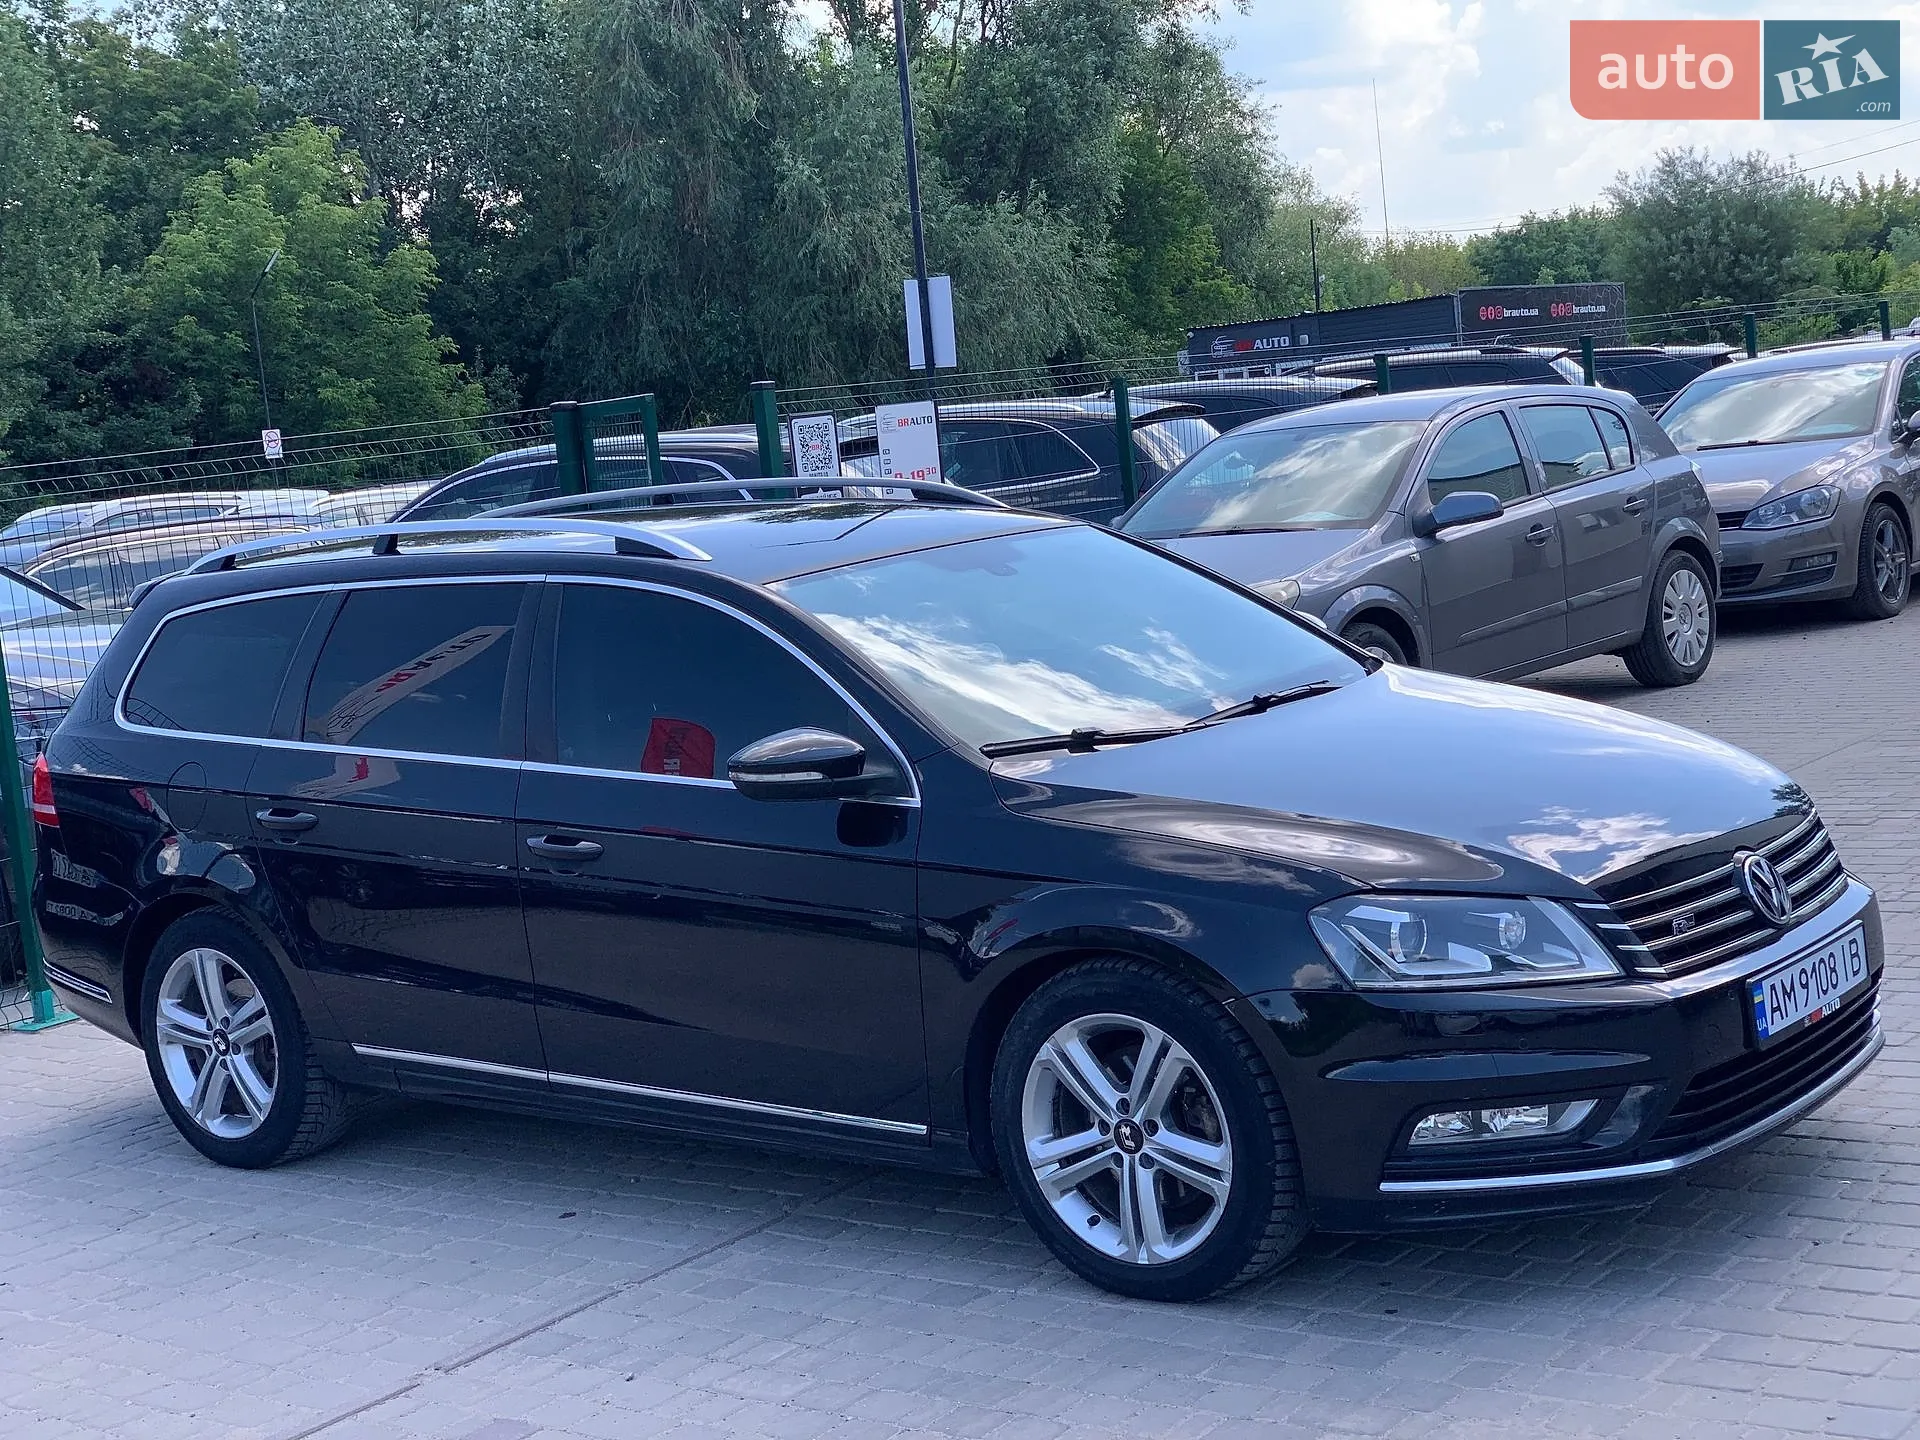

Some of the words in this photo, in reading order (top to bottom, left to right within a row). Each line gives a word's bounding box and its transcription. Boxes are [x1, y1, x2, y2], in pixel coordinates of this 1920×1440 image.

[1503, 307, 1539, 318] brauto.ua
[1572, 304, 1606, 314] brauto.ua
[897, 415, 933, 428] BRAUTO
[1769, 973, 1799, 1026] AM
[1798, 951, 1839, 1008] 9108
[1756, 1016, 1768, 1032] UA
